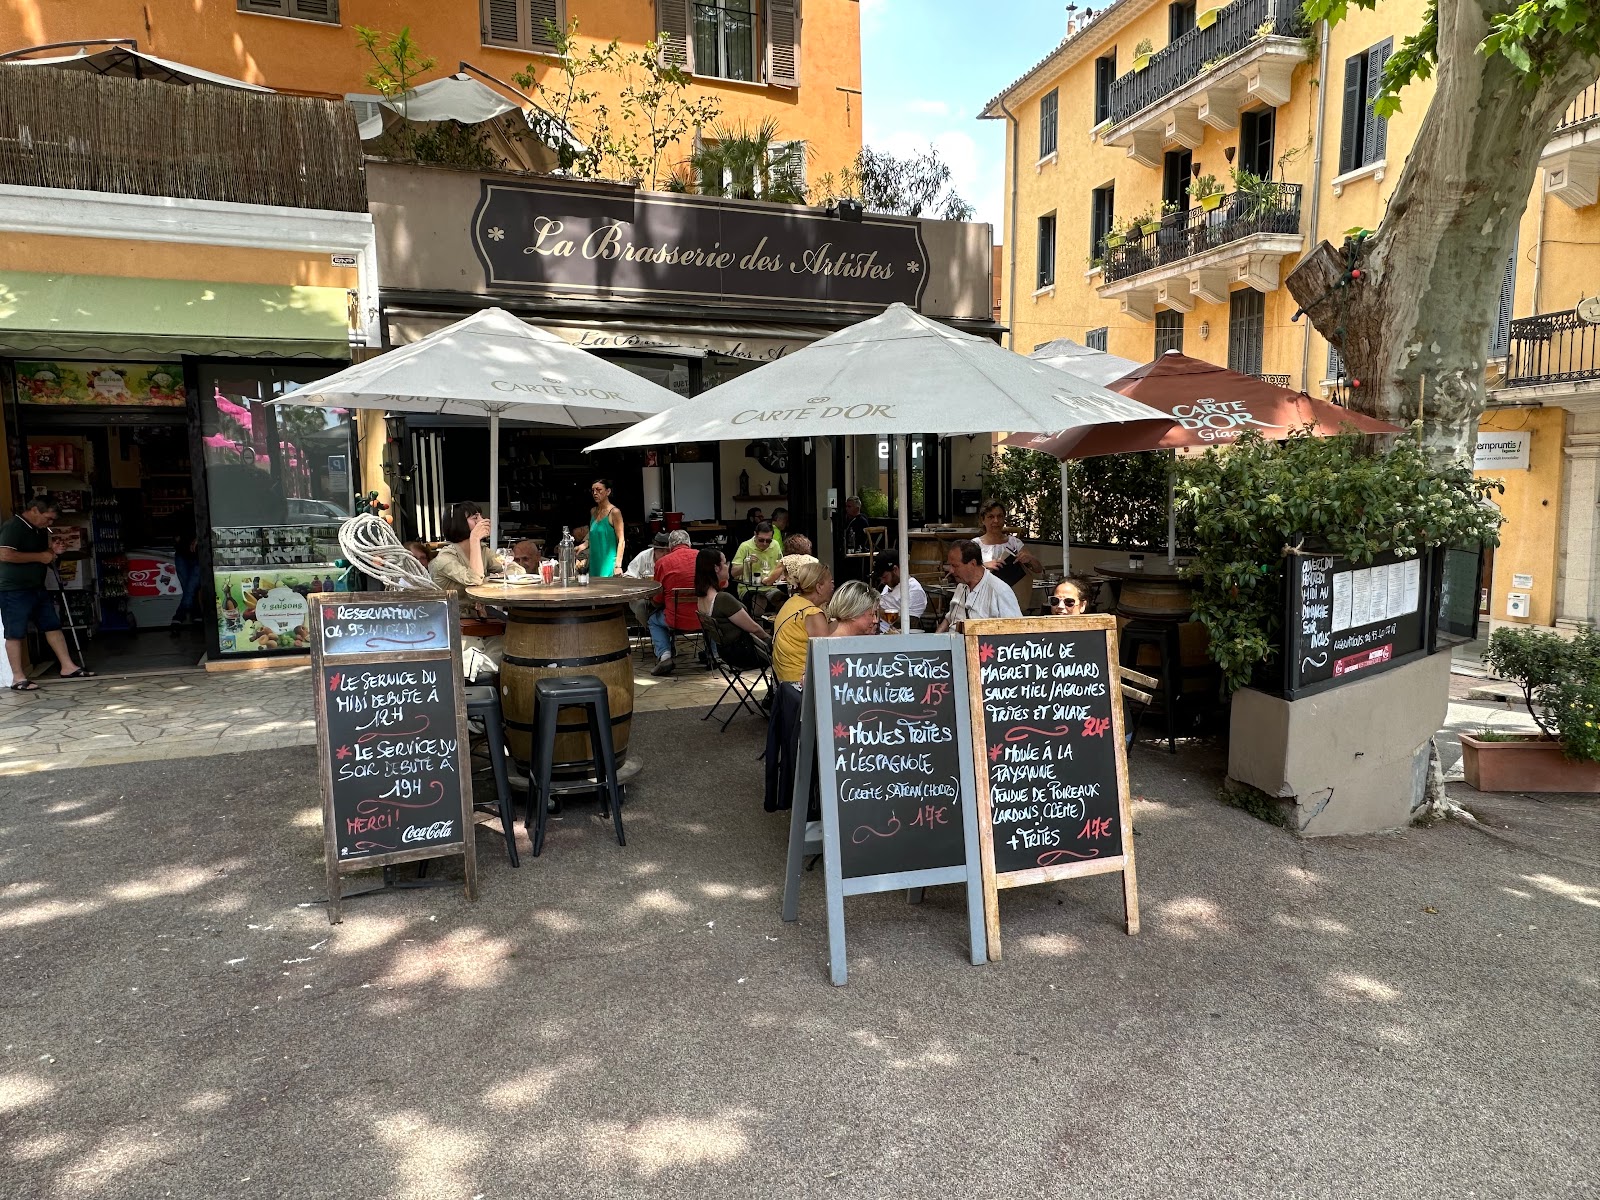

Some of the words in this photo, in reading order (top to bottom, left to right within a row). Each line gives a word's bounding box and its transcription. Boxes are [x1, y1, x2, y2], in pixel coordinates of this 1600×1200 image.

[523, 216, 576, 257] La
[582, 221, 735, 268] Brasserie
[739, 236, 783, 272] des
[789, 242, 895, 279] Artistes
[572, 332, 608, 346] La
[491, 380, 564, 395] CARTE
[568, 387, 635, 404] D'OR
[731, 408, 816, 425] CARTE
[819, 403, 897, 419] D'OR
[1171, 400, 1247, 418] CARTE
[1176, 412, 1284, 430] D'OR
[337, 604, 430, 620] RESERVATIONS
[340, 673, 360, 692] LE
[360, 671, 418, 690] SERVICE
[421, 669, 437, 685] DU
[980, 663, 1033, 685] MAGRET
[1035, 663, 1049, 681] DE
[1051, 662, 1100, 679] CANARD
[335, 690, 368, 713] MIDI
[1032, 704, 1051, 721] ET
[1052, 702, 1092, 721] SALADE
[354, 743, 374, 761] LE
[376, 736, 438, 759] SERVICE
[437, 738, 457, 757] DU
[1057, 743, 1074, 761] LA
[990, 763, 1057, 784] PAYSANNE
[379, 778, 422, 799] 19H
[1032, 786, 1048, 803] DE
[1046, 780, 1101, 800] POIREAUX
